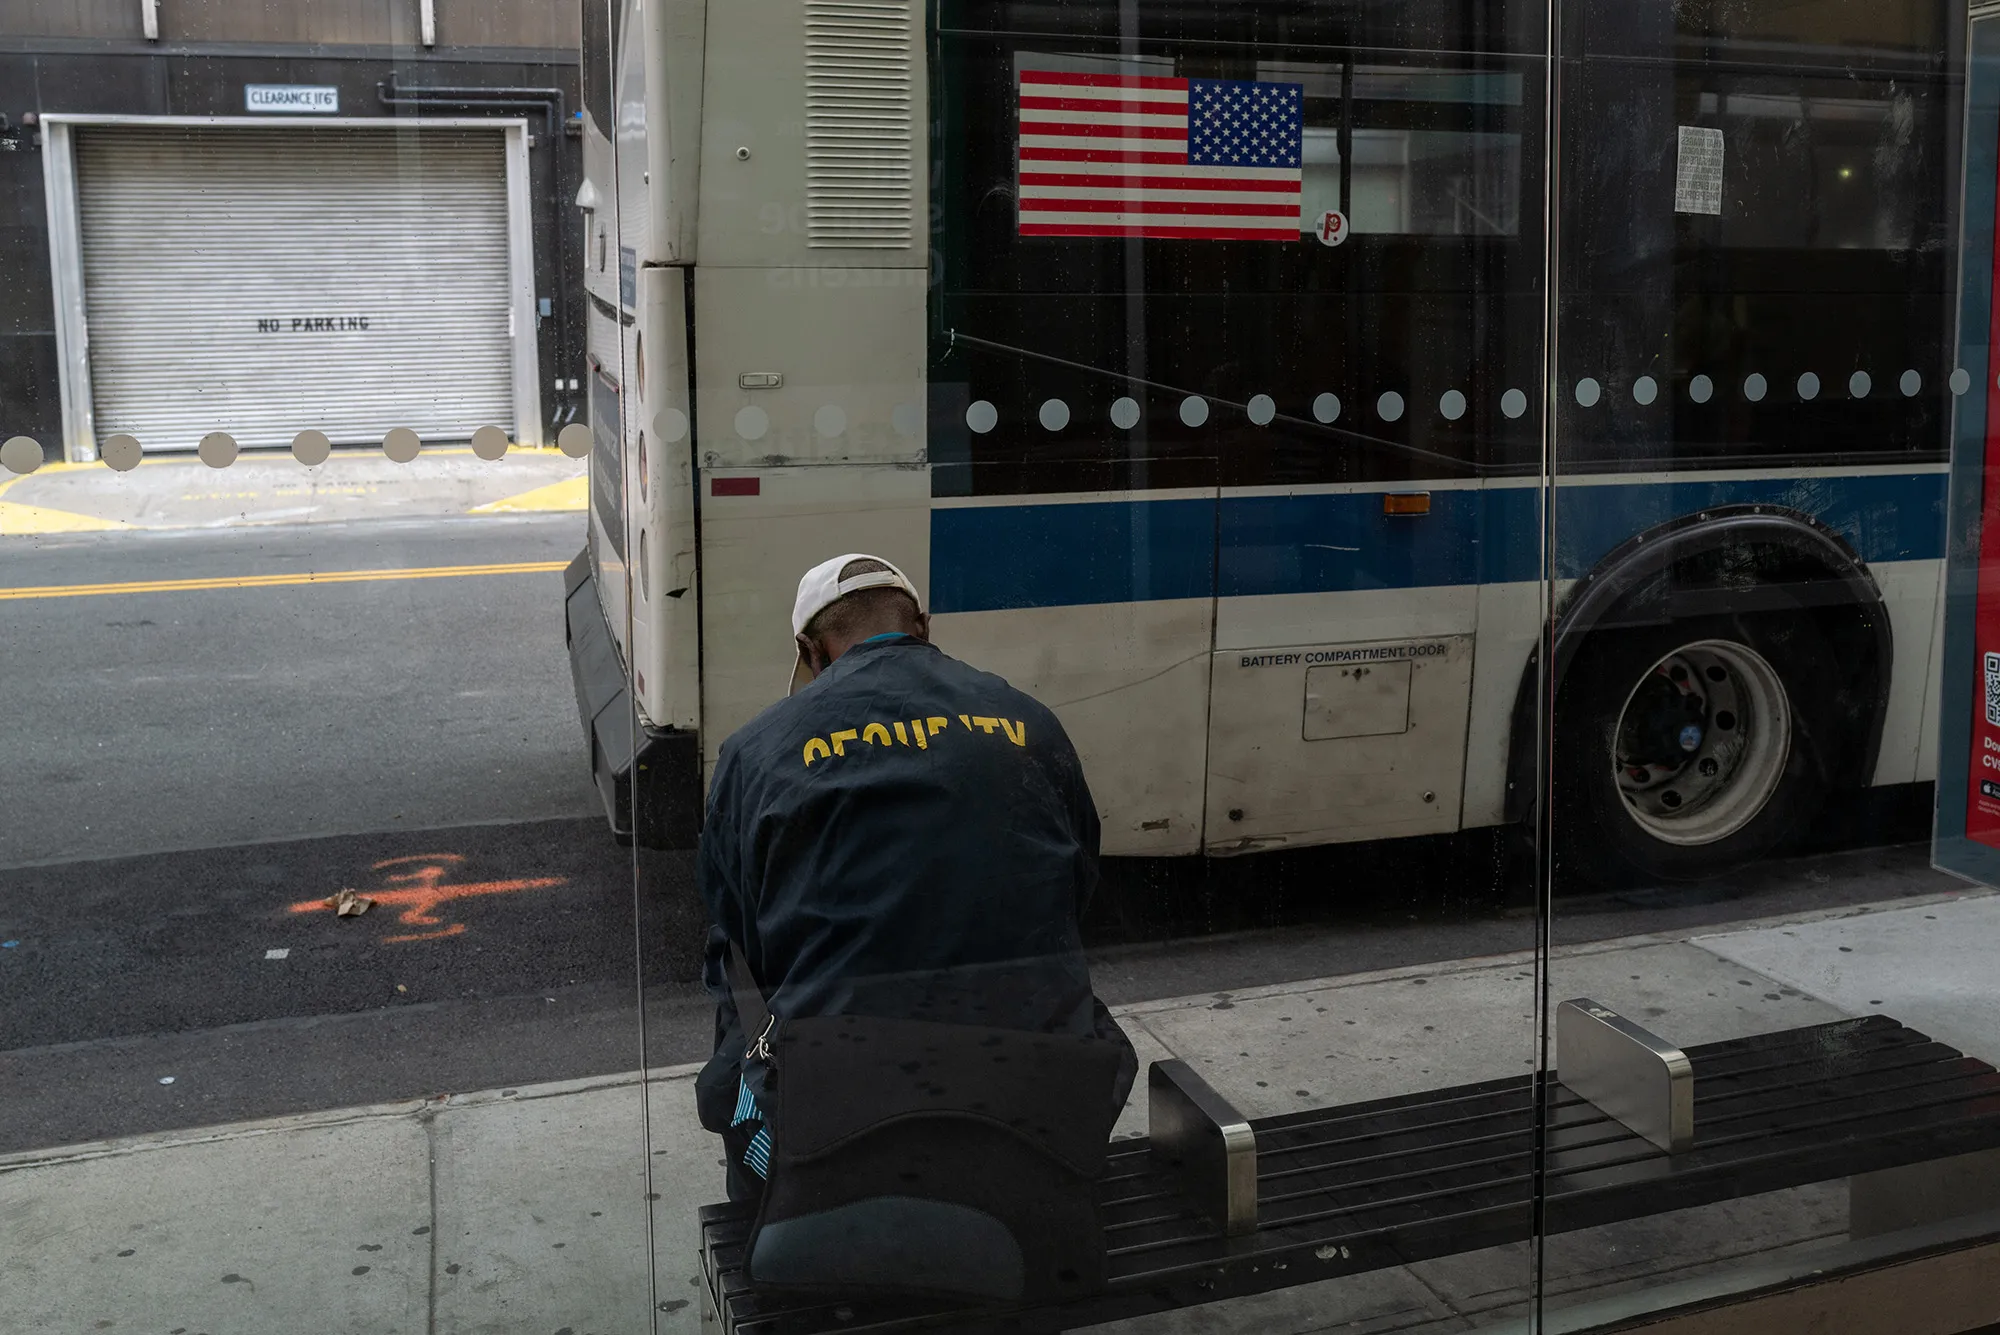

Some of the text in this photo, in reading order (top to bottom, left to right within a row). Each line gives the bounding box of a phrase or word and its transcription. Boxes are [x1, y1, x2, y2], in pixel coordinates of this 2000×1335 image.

[251, 91, 311, 105] CLEARANCE
[258, 317, 369, 332] NO PARKING
[1241, 644, 1446, 668] BATTERY COMPARTMENT DOOR
[803, 714, 1026, 767] SECUTY
